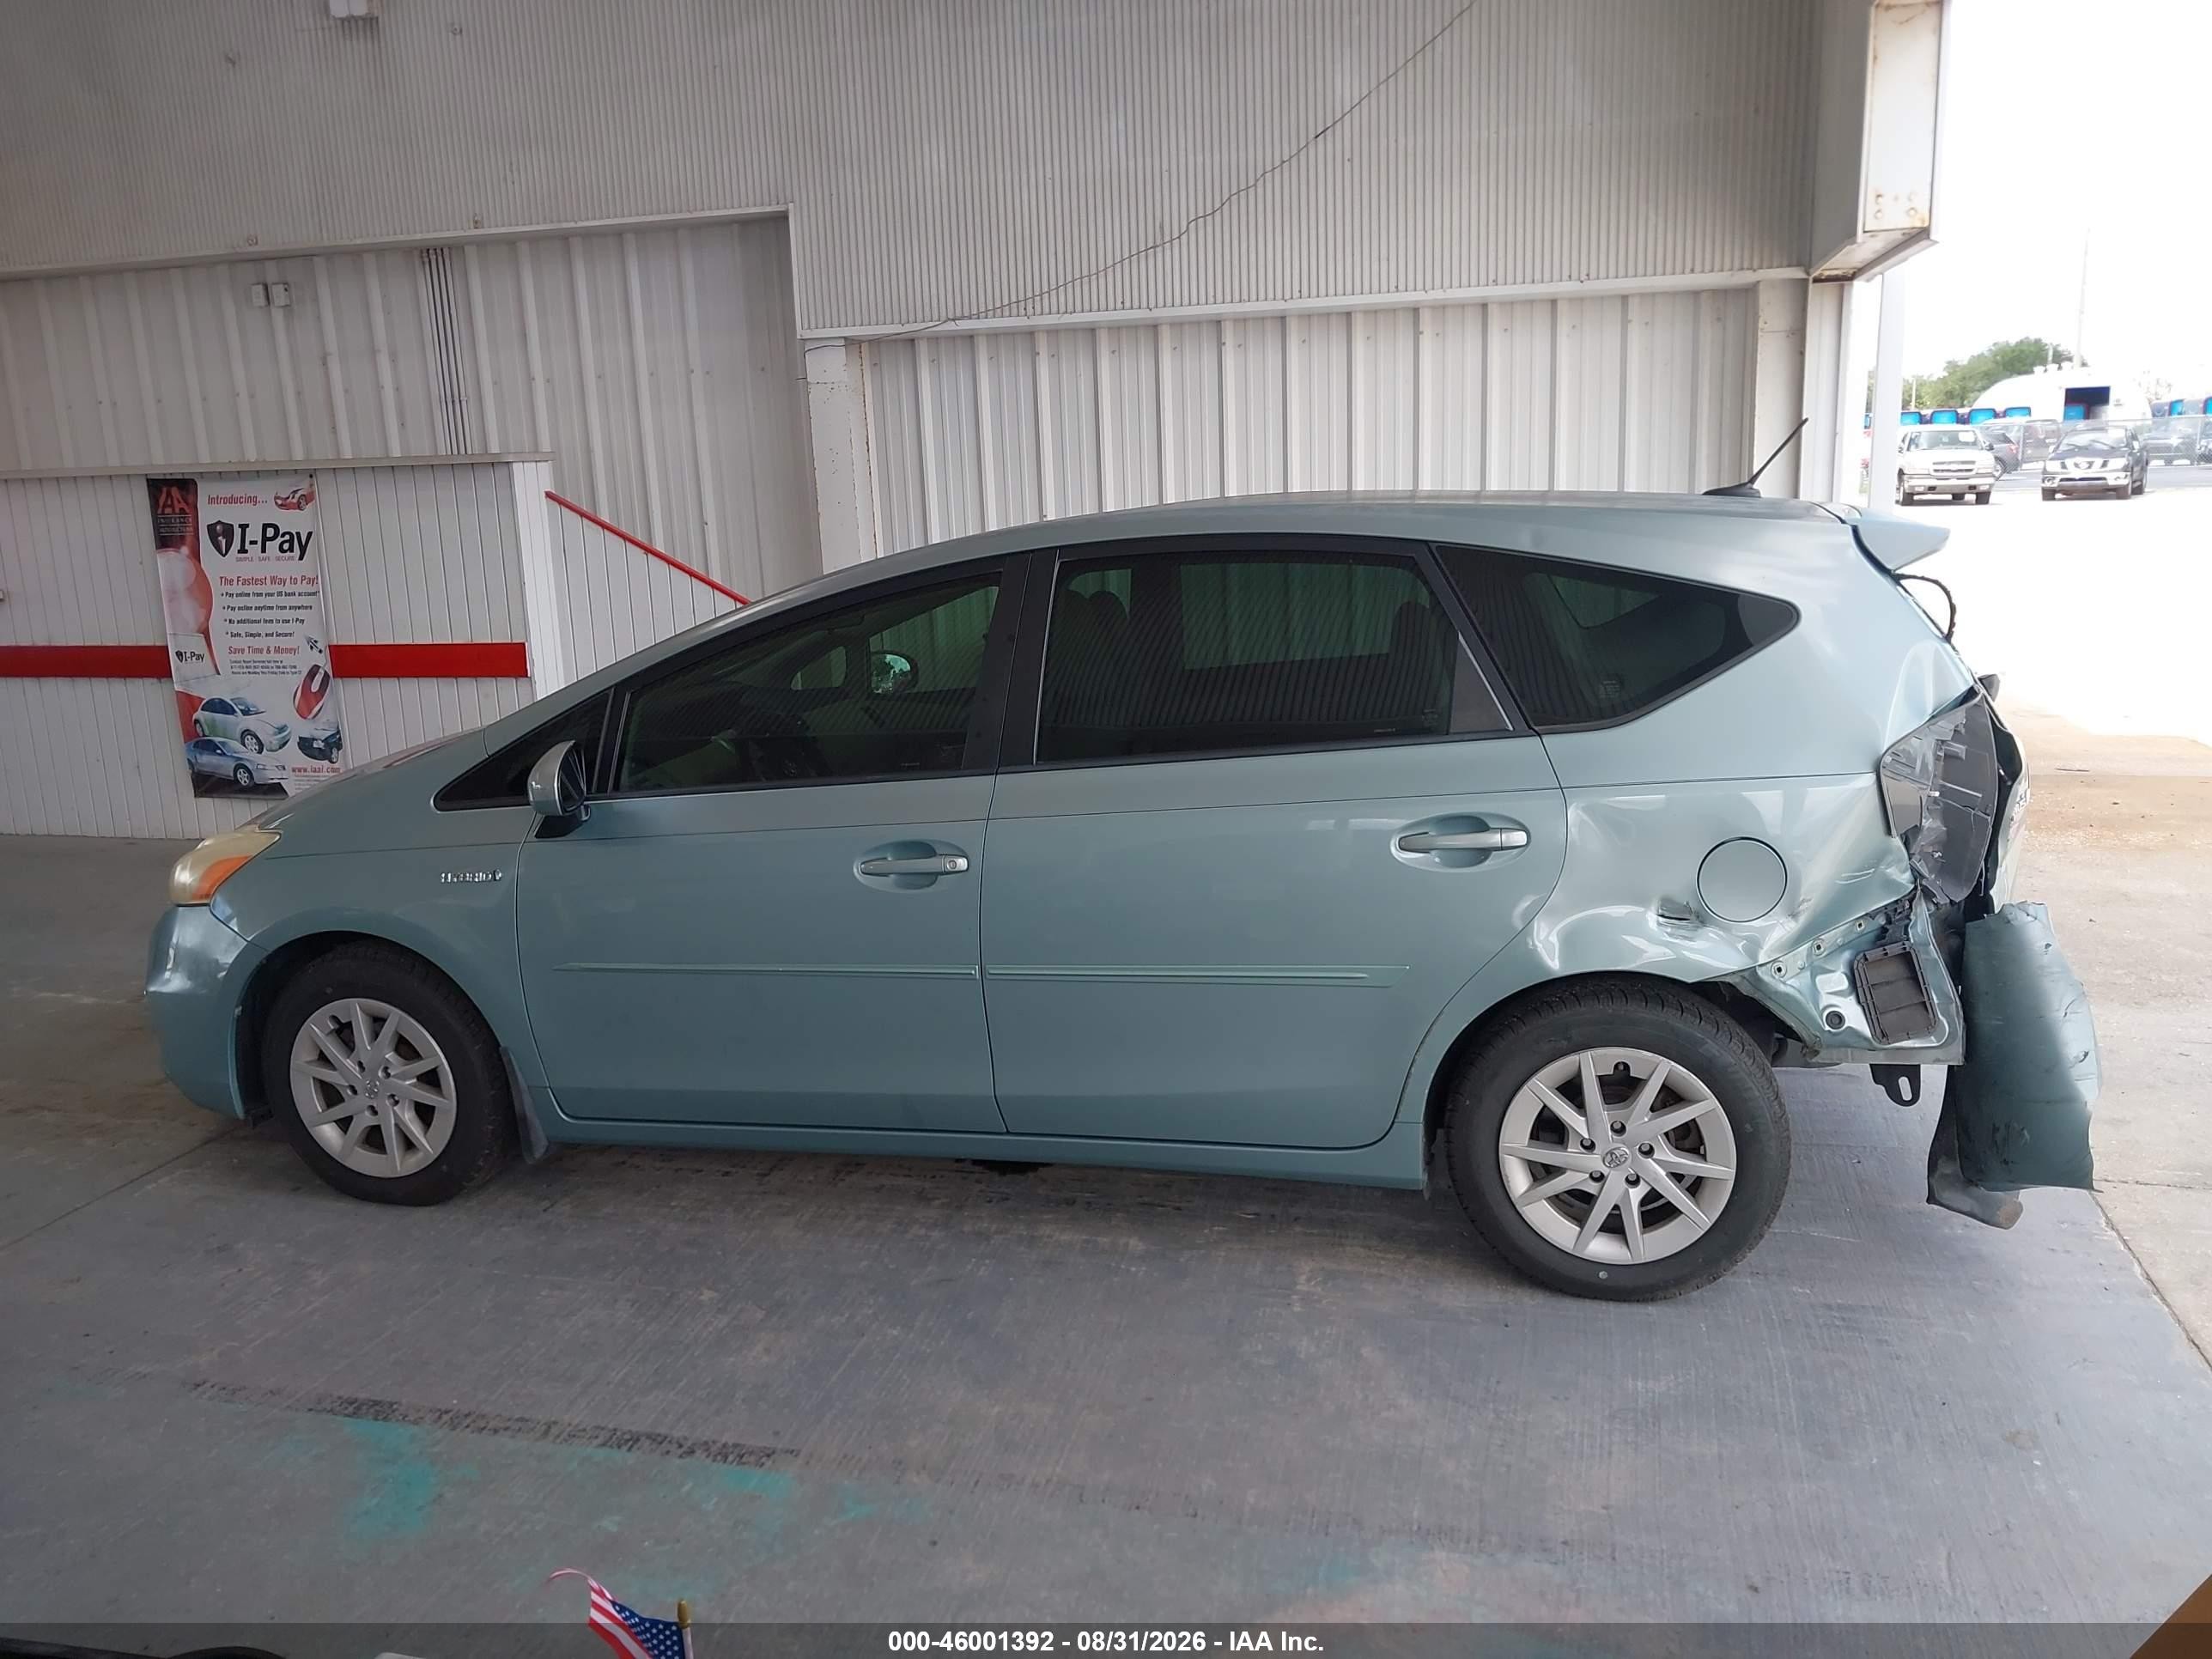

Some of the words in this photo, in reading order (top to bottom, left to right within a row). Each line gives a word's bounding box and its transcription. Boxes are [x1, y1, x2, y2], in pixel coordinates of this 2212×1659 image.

[208, 495, 268, 506] Introducing...
[237, 522, 313, 561] I-Pay
[220, 575, 234, 586] The
[237, 575, 267, 586] Fastest
[270, 575, 287, 587] Way
[289, 575, 298, 585] to
[301, 574, 319, 587] Pay!
[228, 646, 246, 654] Save
[247, 646, 264, 654] Time
[265, 646, 271, 654] &
[273, 645, 300, 655] Money!
[184, 651, 205, 662] I-Pay
